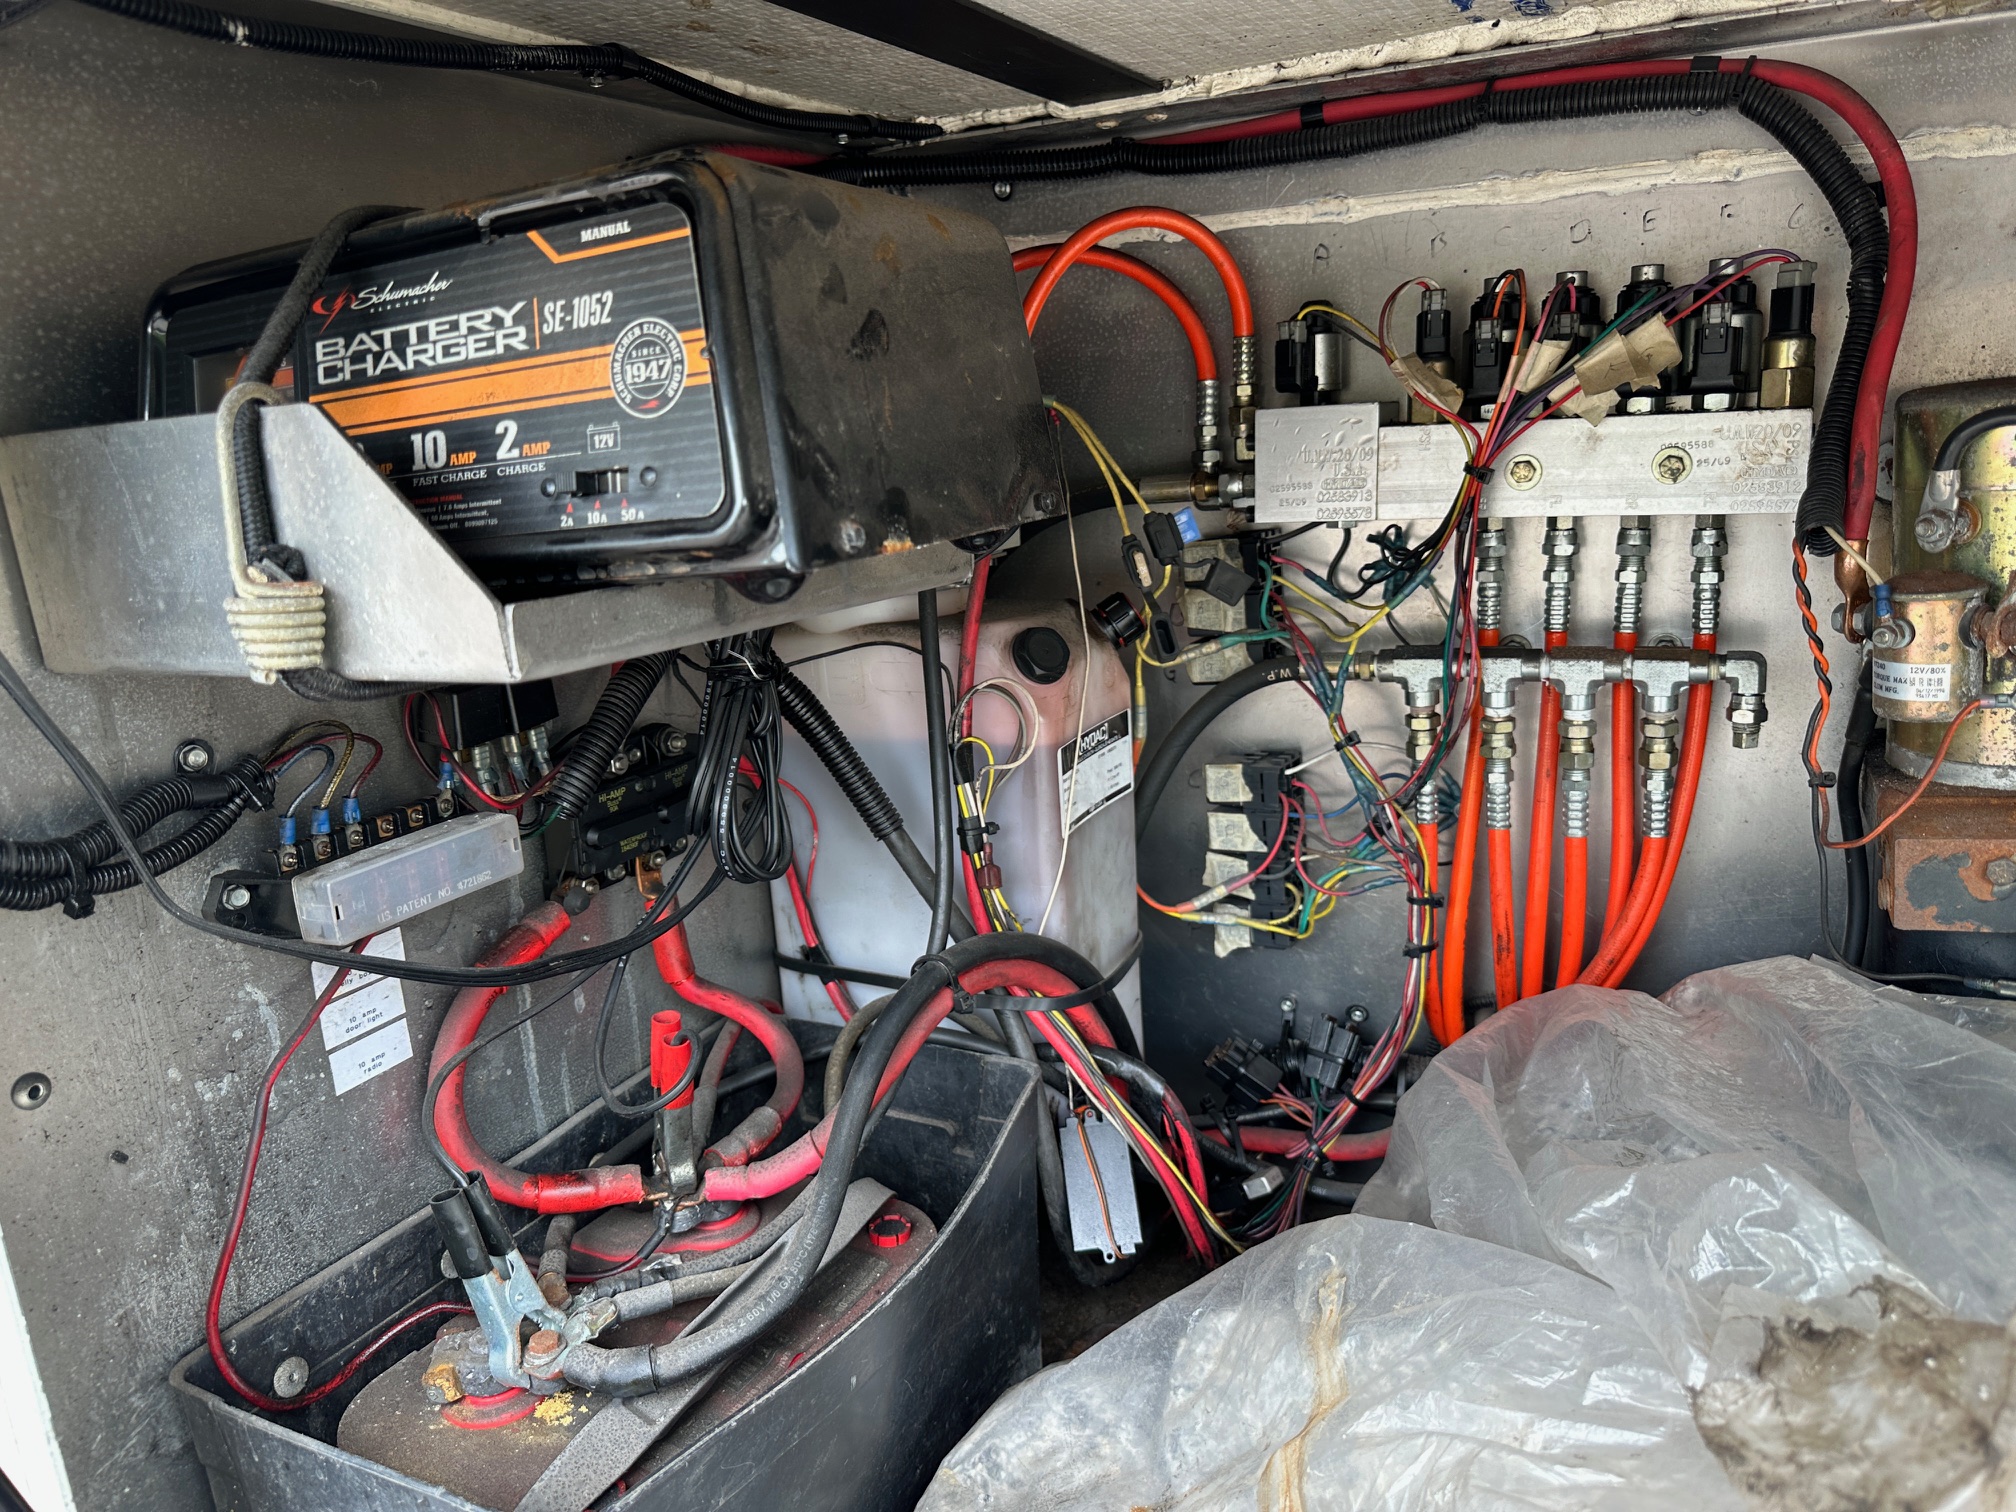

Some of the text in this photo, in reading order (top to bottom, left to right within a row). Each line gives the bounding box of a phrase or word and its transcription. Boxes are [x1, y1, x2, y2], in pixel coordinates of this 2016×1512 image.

[1642, 207, 1662, 233] E
[580, 221, 632, 243] MANUAL
[351, 270, 453, 310] Schumacher
[370, 296, 435, 313] ELECTRIC
[542, 289, 613, 335] SE-1052
[316, 301, 528, 363] BATTERY
[317, 325, 530, 386] CHARGER
[613, 325, 642, 405] SCHUMACHER
[642, 322, 683, 362] ELECTRIC
[631, 346, 662, 358] SINCE
[624, 358, 673, 385] 1947
[410, 419, 551, 472] 10 AMP 2 AMP
[593, 432, 615, 450] 12V
[375, 462, 394, 476] MP
[413, 476, 439, 487] FAST
[440, 469, 488, 483] CHARGE
[496, 462, 547, 477] CHARGE
[560, 514, 574, 527] 2A
[1909, 666, 1947, 675] 12V/80%
[598, 786, 626, 804] HI-AMP
[396, 893, 433, 916] PATENT
[437, 886, 454, 899] NO.
[345, 1011, 384, 1034] door light
[348, 1007, 377, 1024] 10 amp
[358, 1052, 386, 1069] 10 amp
[363, 1061, 383, 1074] radio
[737, 1317, 747, 1328] 2
[747, 1303, 767, 1321] 60V
[766, 1289, 781, 1304] 1/0
[779, 1274, 794, 1291] GA
